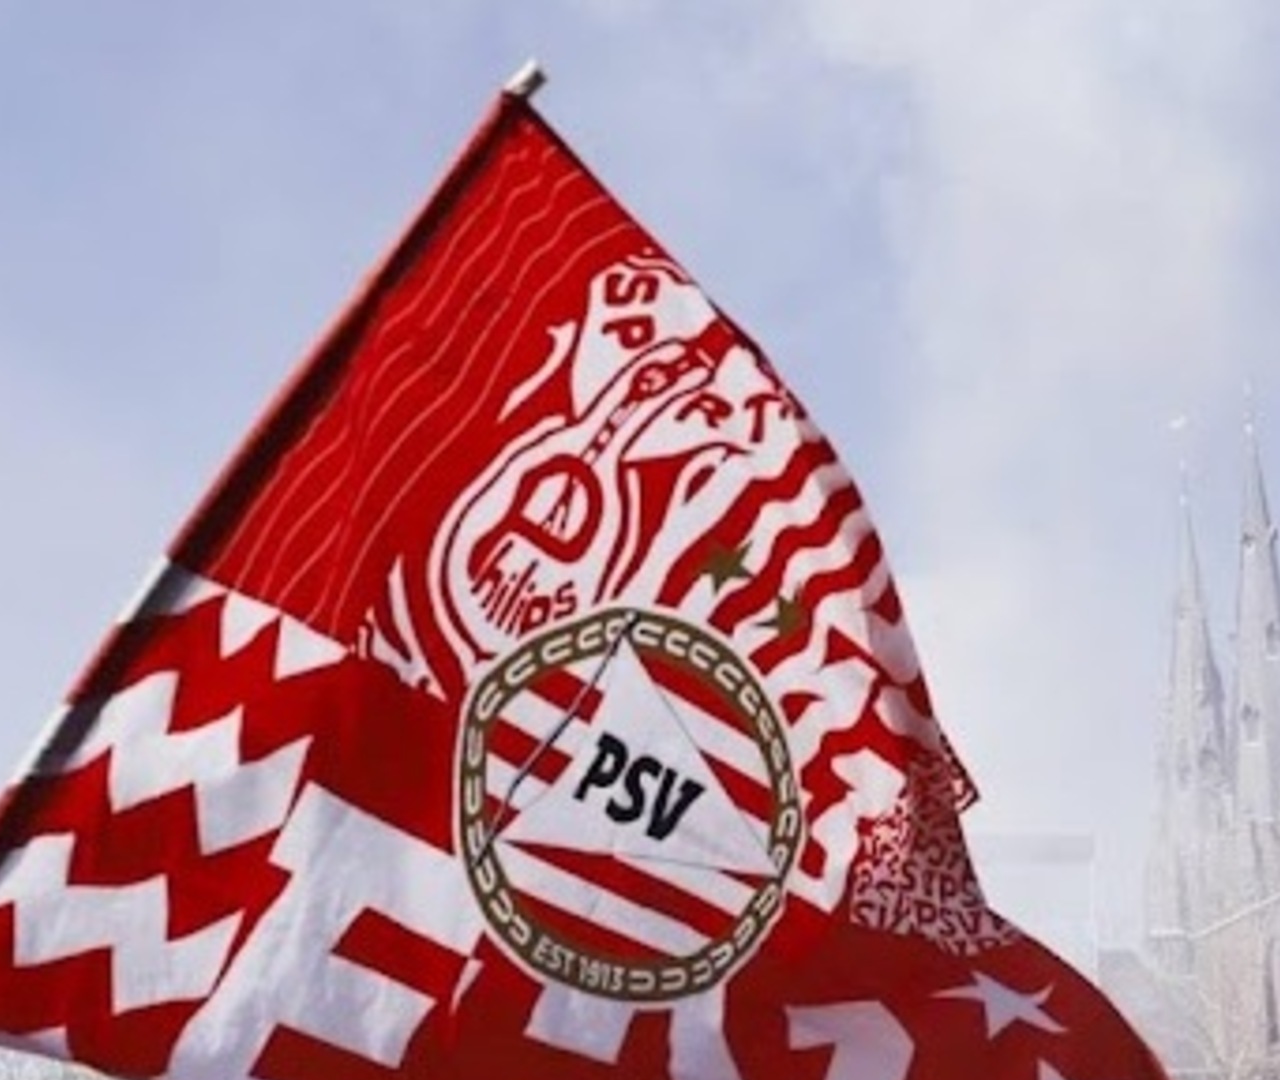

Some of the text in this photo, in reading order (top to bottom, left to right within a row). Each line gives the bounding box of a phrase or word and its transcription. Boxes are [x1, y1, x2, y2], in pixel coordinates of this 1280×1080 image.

[573, 732, 705, 842] PSV
[532, 936, 626, 991] EST 1913
